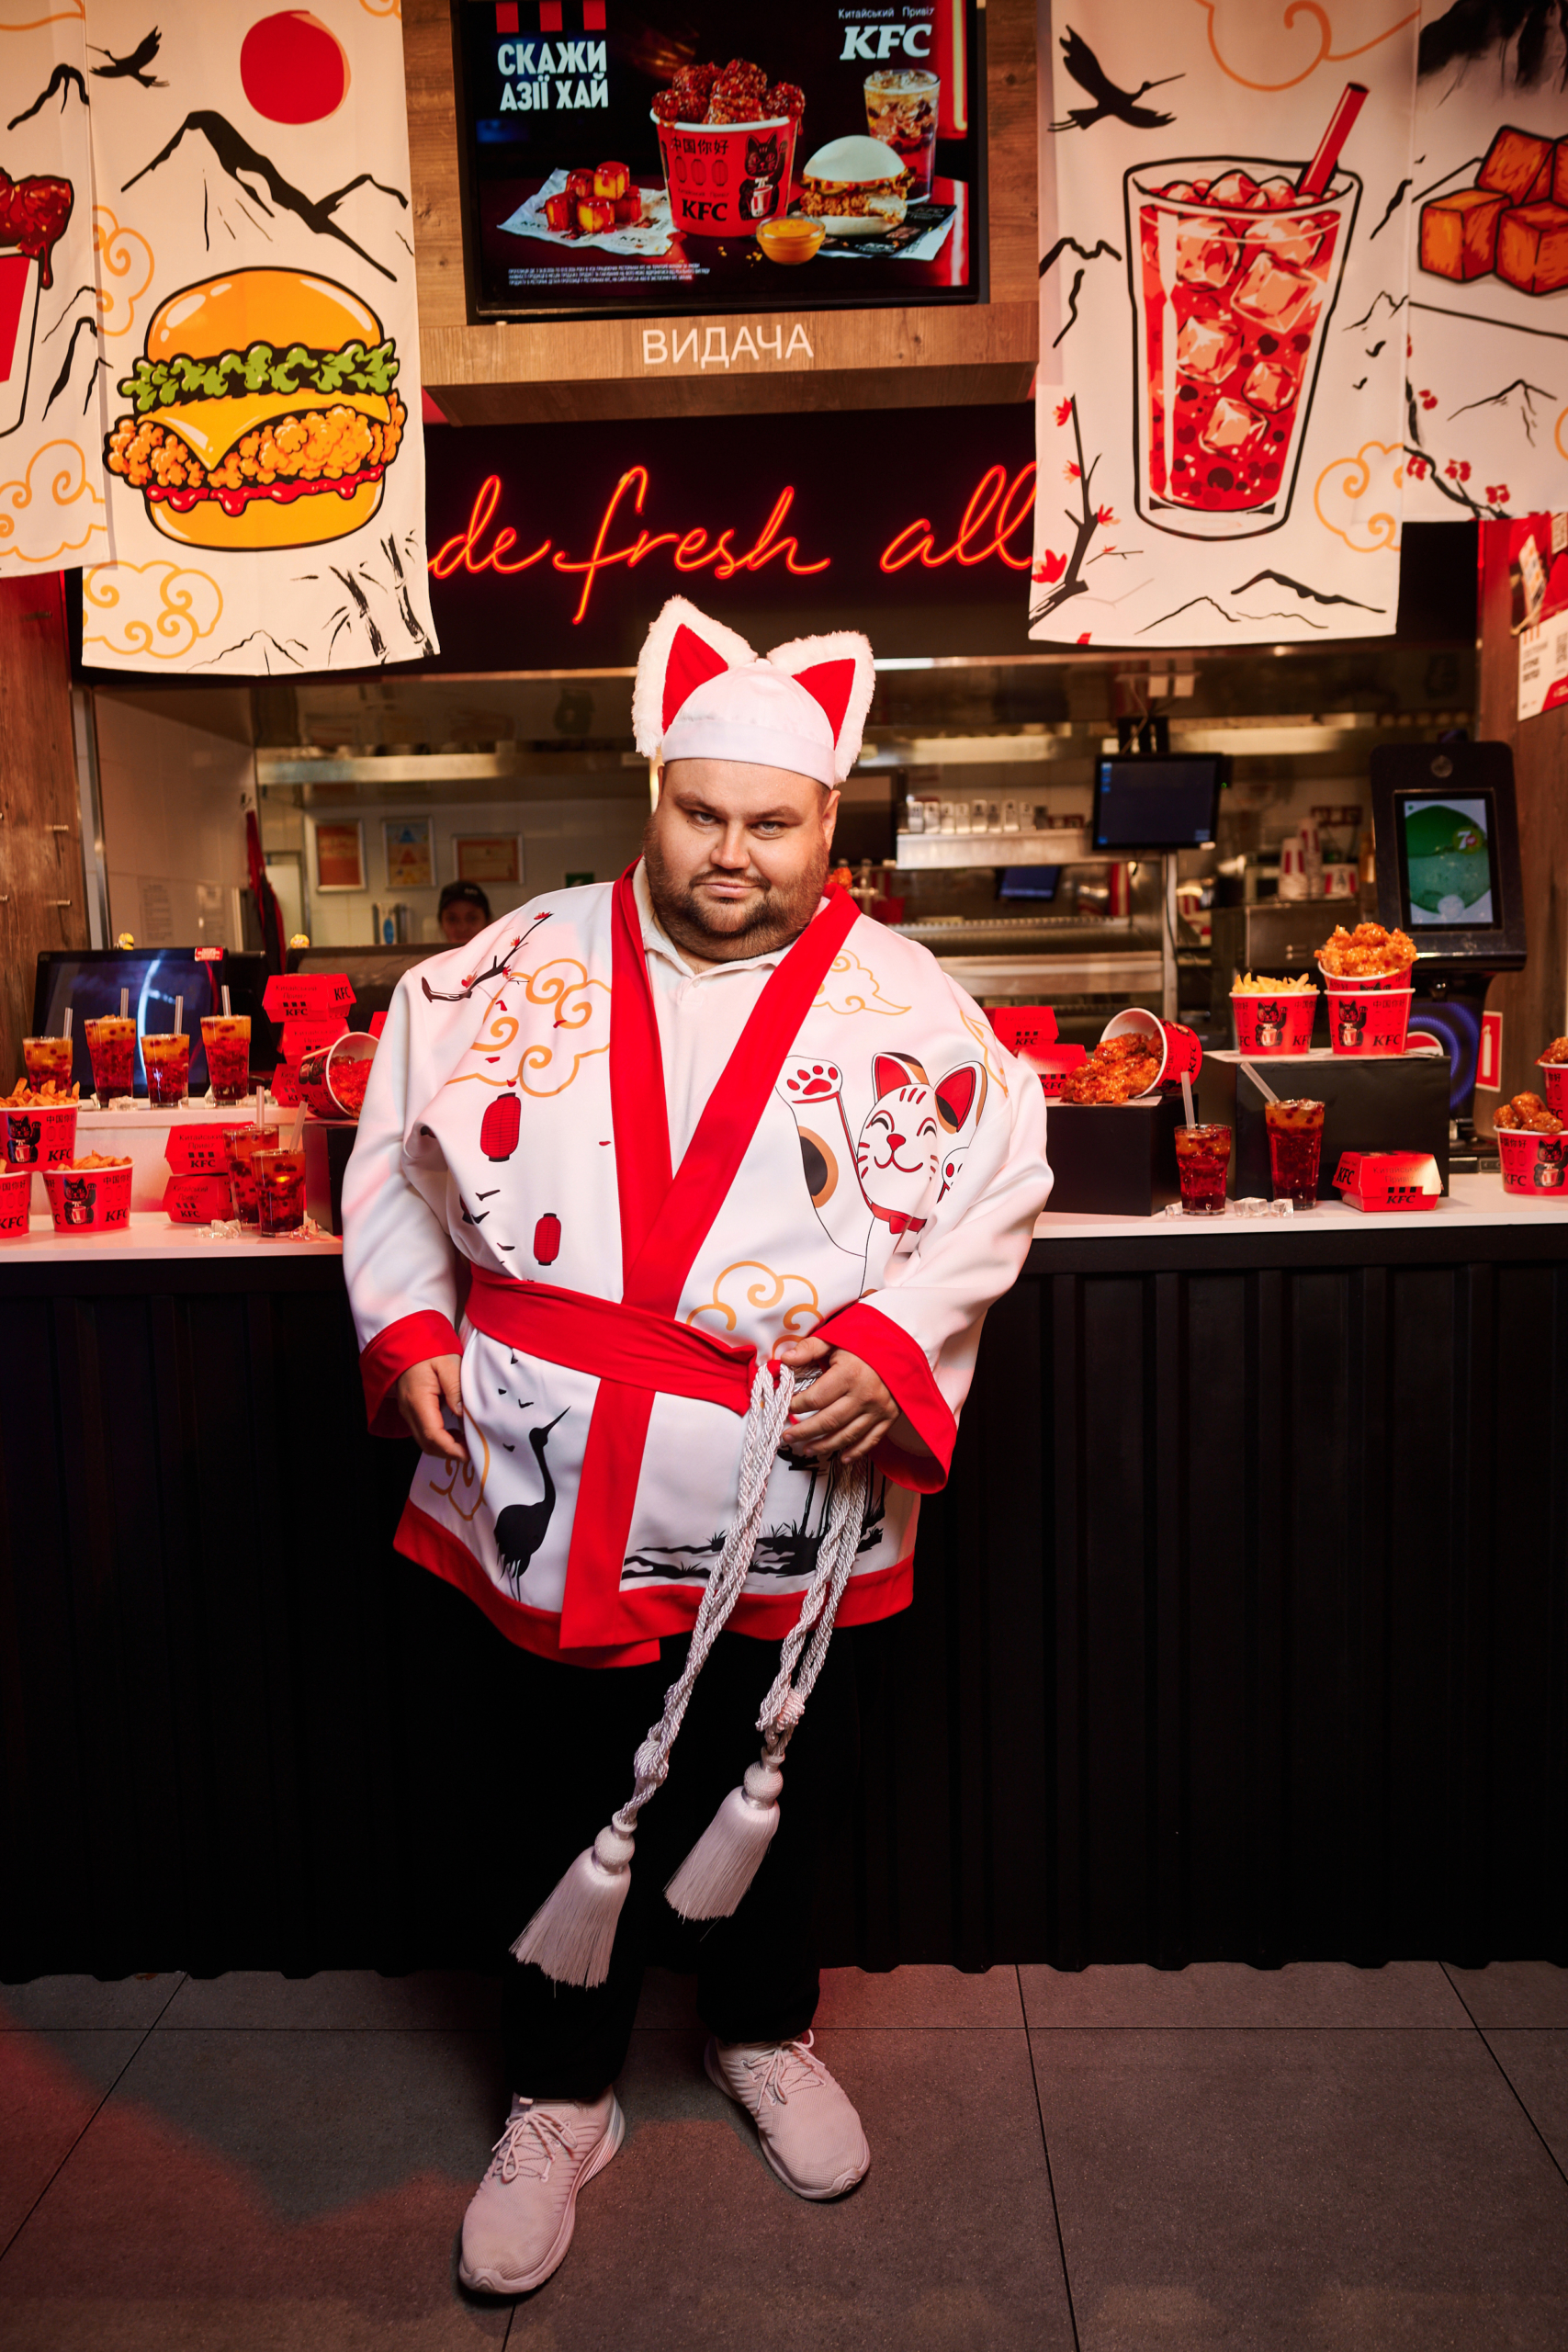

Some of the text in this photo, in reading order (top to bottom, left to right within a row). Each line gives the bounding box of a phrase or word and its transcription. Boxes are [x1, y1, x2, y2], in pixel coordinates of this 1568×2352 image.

[838, 7, 895, 19] Китайський
[839, 23, 932, 61] KFC
[497, 40, 607, 75] СКАЖИ
[500, 72, 609, 111] АЗІЇ ХАЙ
[671, 137, 729, 155] 中国你好
[682, 198, 728, 221] KFC
[643, 323, 815, 369] ВИДАЧА
[553, 465, 832, 624] fresh
[880, 463, 1037, 573] all
[333, 986, 351, 1001] KFC
[285, 1008, 308, 1017] KFC
[1015, 1037, 1038, 1046] KFC
[1238, 1035, 1251, 1047] FC
[1372, 1034, 1401, 1047] KFC
[1188, 1042, 1197, 1075] KFC
[1549, 1108, 1563, 1121] FC
[47, 1148, 73, 1162] KFC
[190, 1159, 216, 1169] KFC
[1337, 1167, 1355, 1185] KFC
[1504, 1172, 1527, 1187] KFC
[0, 1180, 26, 1192] 国你好
[1386, 1194, 1416, 1204] KFC
[105, 1207, 128, 1222] KFC
[180, 1210, 200, 1218] KFC
